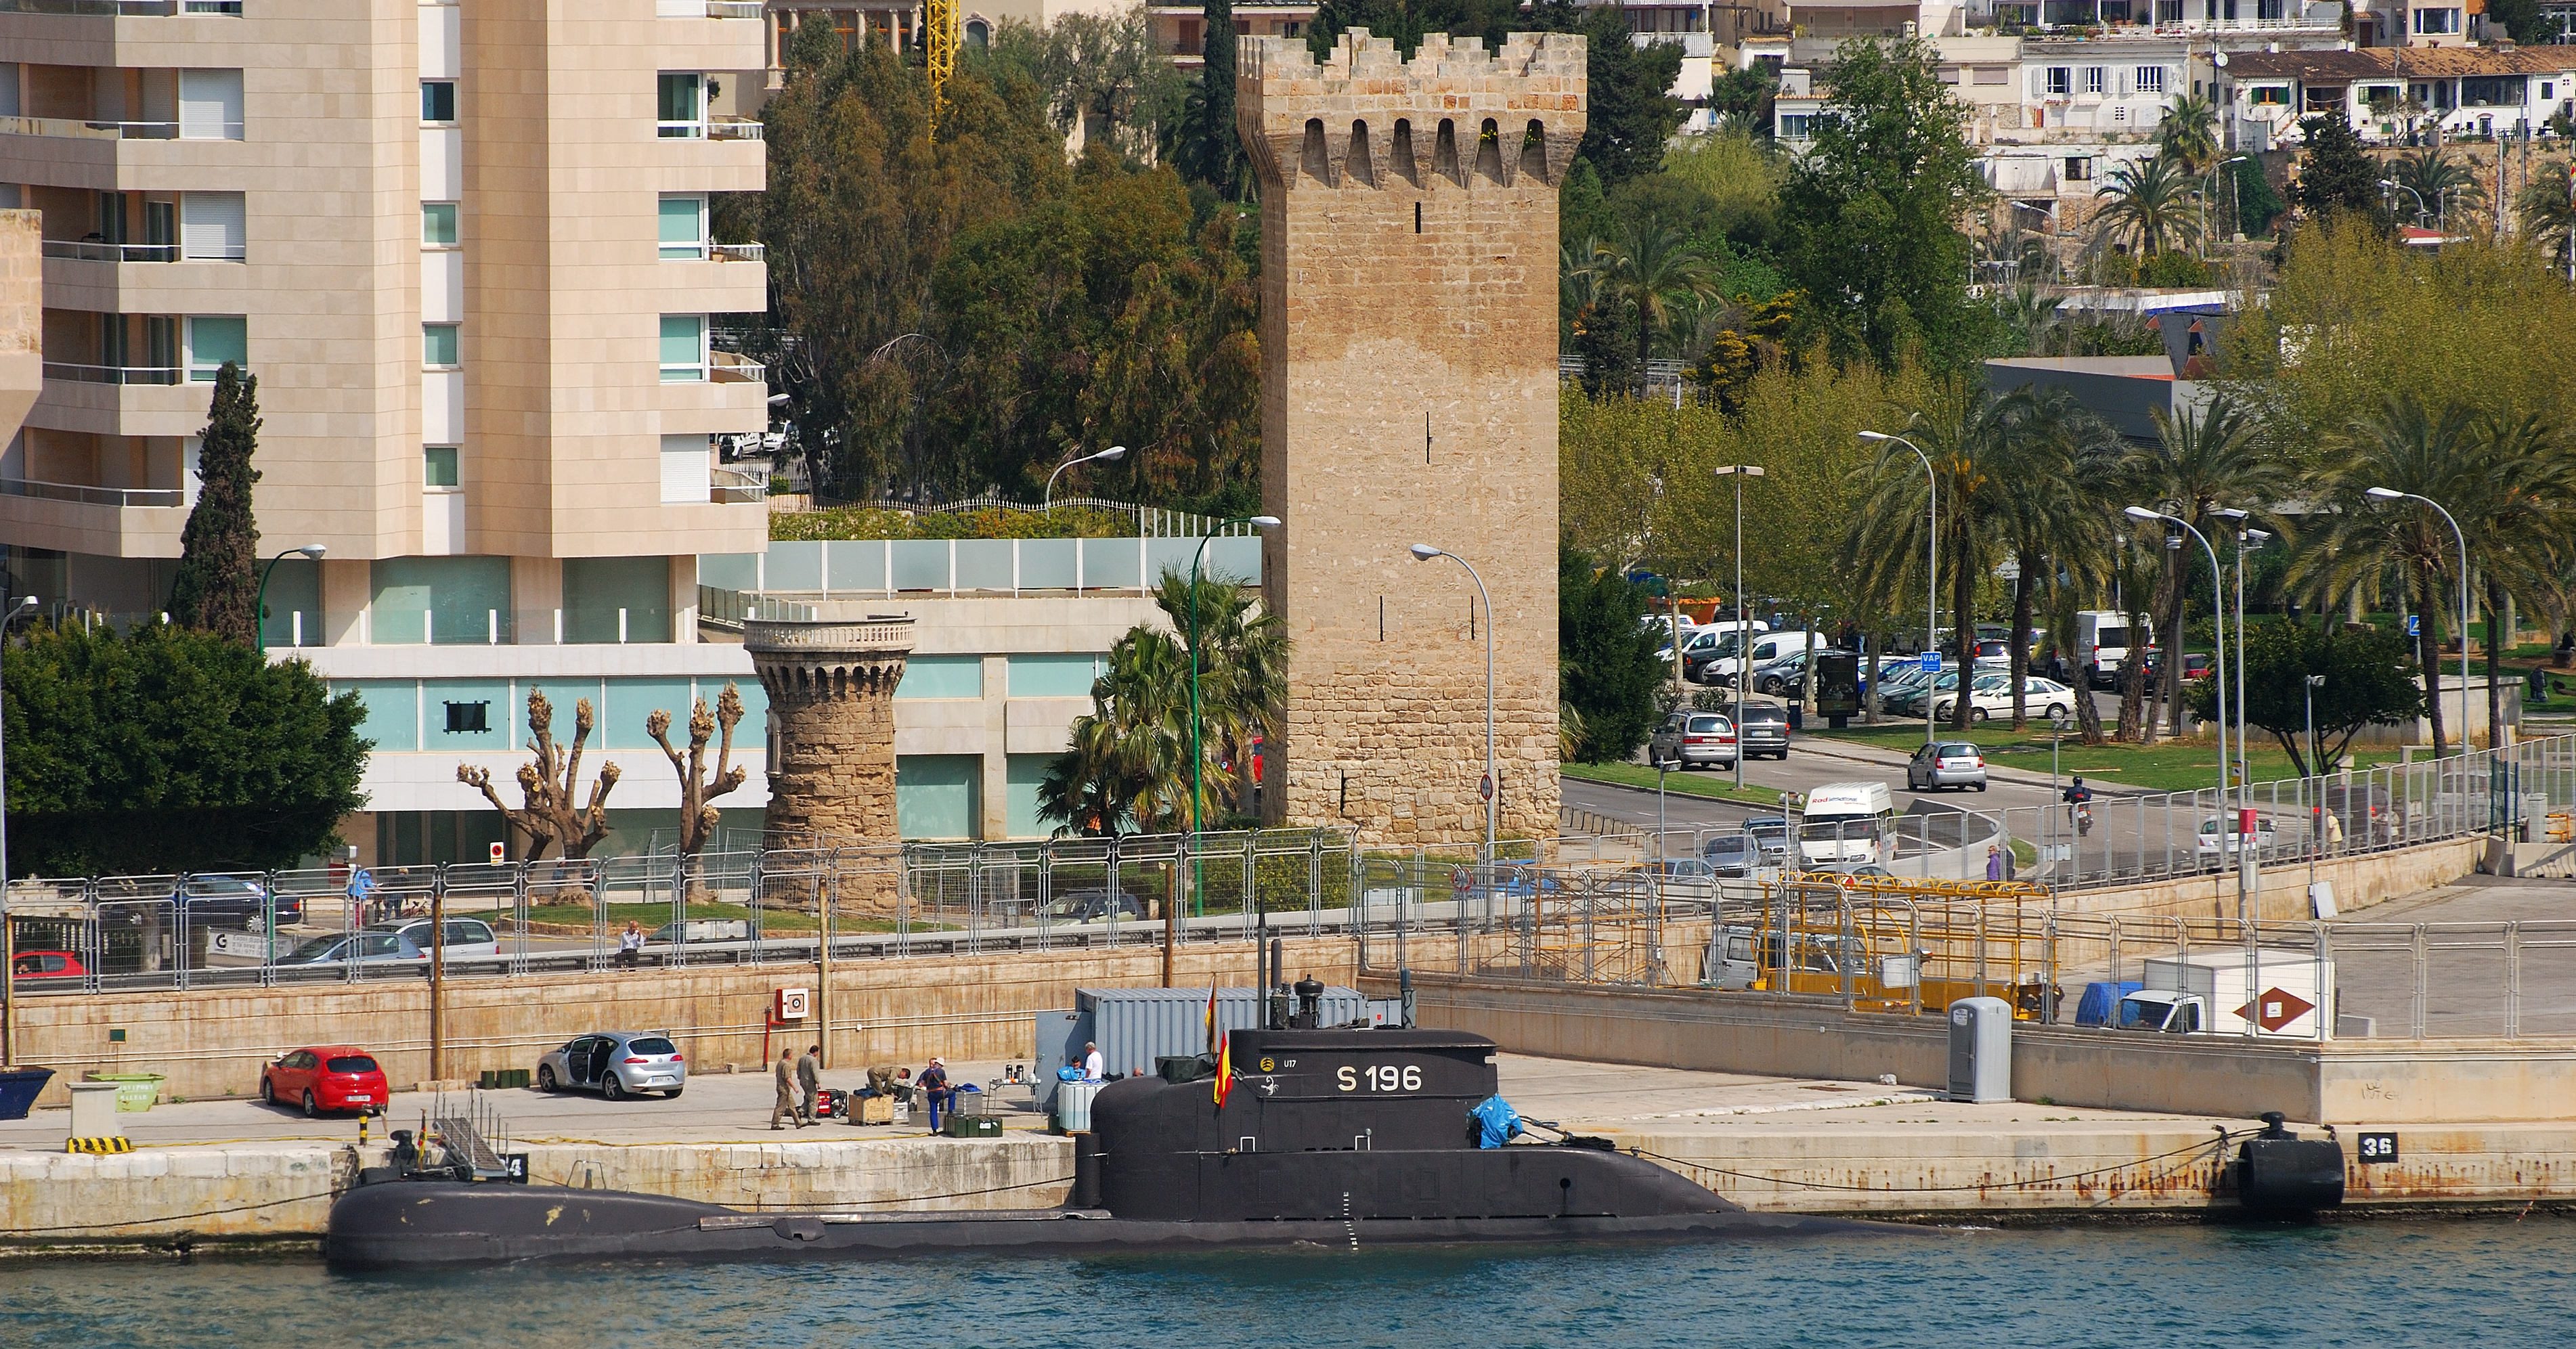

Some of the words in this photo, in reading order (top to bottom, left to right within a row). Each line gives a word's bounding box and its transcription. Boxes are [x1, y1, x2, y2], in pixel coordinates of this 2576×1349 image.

[1336, 1066, 1357, 1091] S
[1365, 1065, 1422, 1091] 196
[2364, 1138, 2392, 1156] 36
